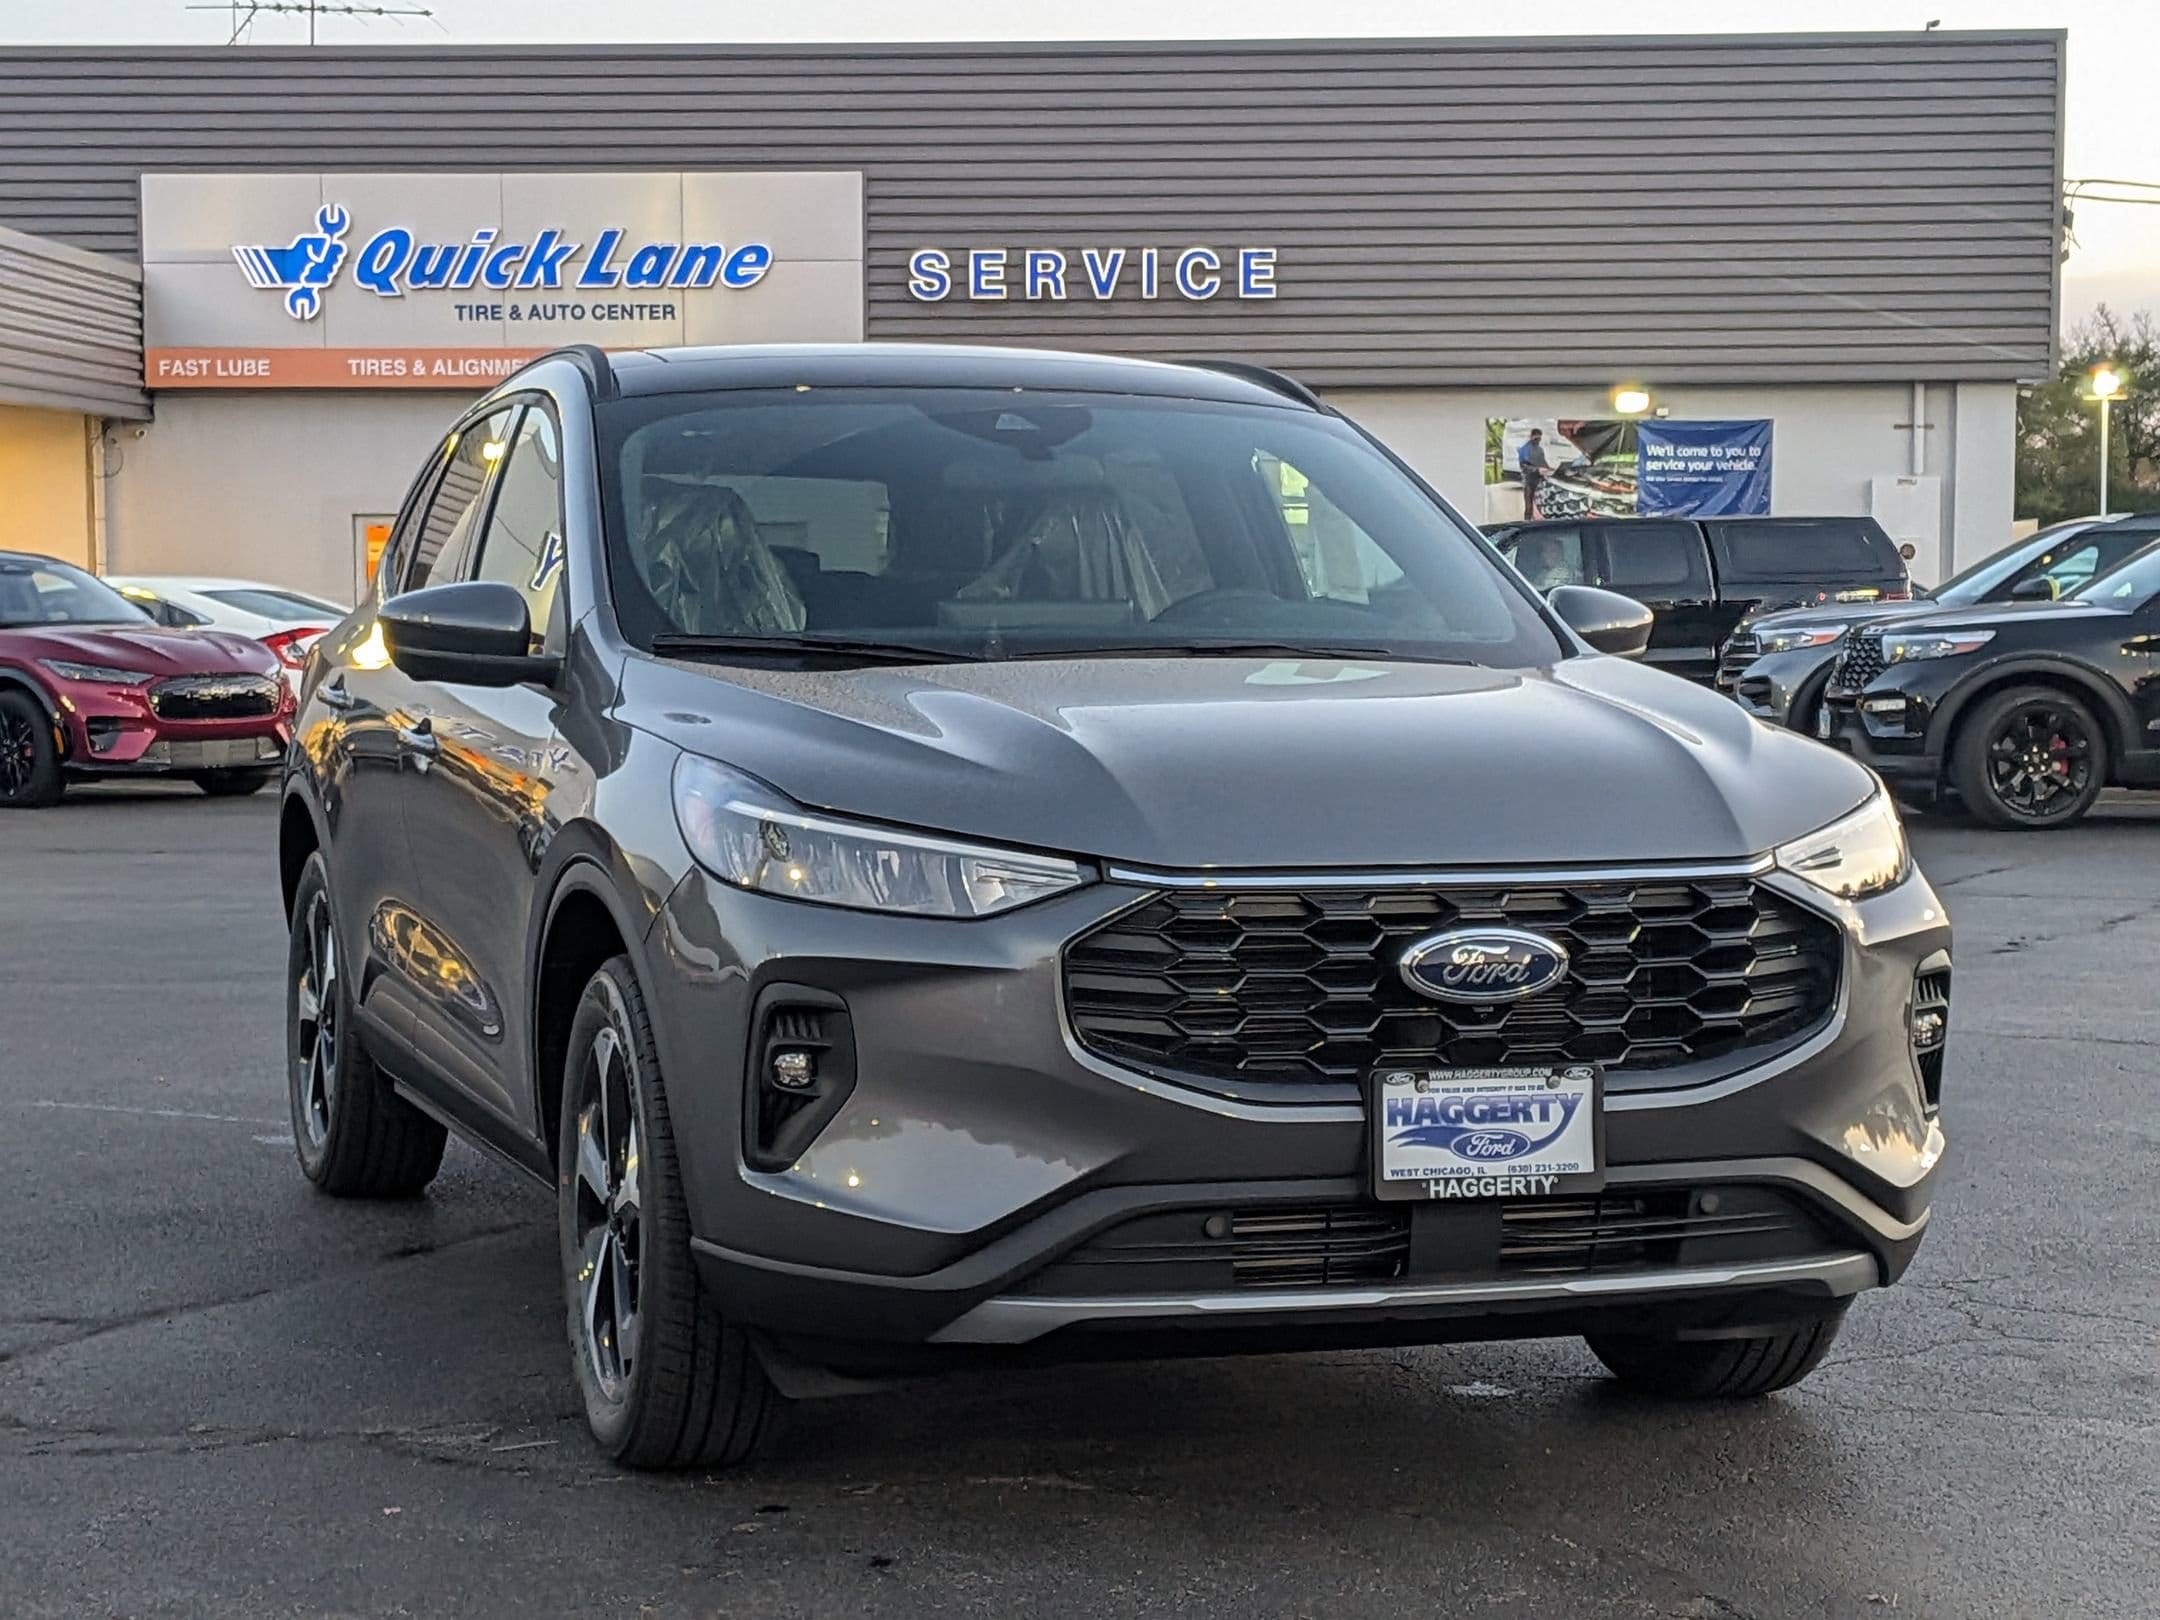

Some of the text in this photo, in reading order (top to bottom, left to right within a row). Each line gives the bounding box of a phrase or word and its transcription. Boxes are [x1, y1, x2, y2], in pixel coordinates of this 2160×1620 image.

[353, 227, 773, 297] Quick Lane
[908, 248, 1277, 301] SERVICE
[454, 303, 676, 321] TIRE & AUTO CENTER
[158, 359, 271, 377] FAST LUBE
[347, 358, 529, 376] TIRES & ALIGNME
[1646, 445, 1761, 459] We'll come to you to
[1646, 459, 1686, 471] service
[1688, 460, 1714, 472] your
[1442, 944, 1532, 985] Ford
[1386, 1092, 1584, 1127] HAGGERTY
[1466, 1134, 1517, 1157] Ford
[1390, 1167, 1488, 1178] WEST CHICAGO, IL
[1507, 1162, 1580, 1174] (630) 231-3200
[1429, 1175, 1555, 1199] HAGGERTY
